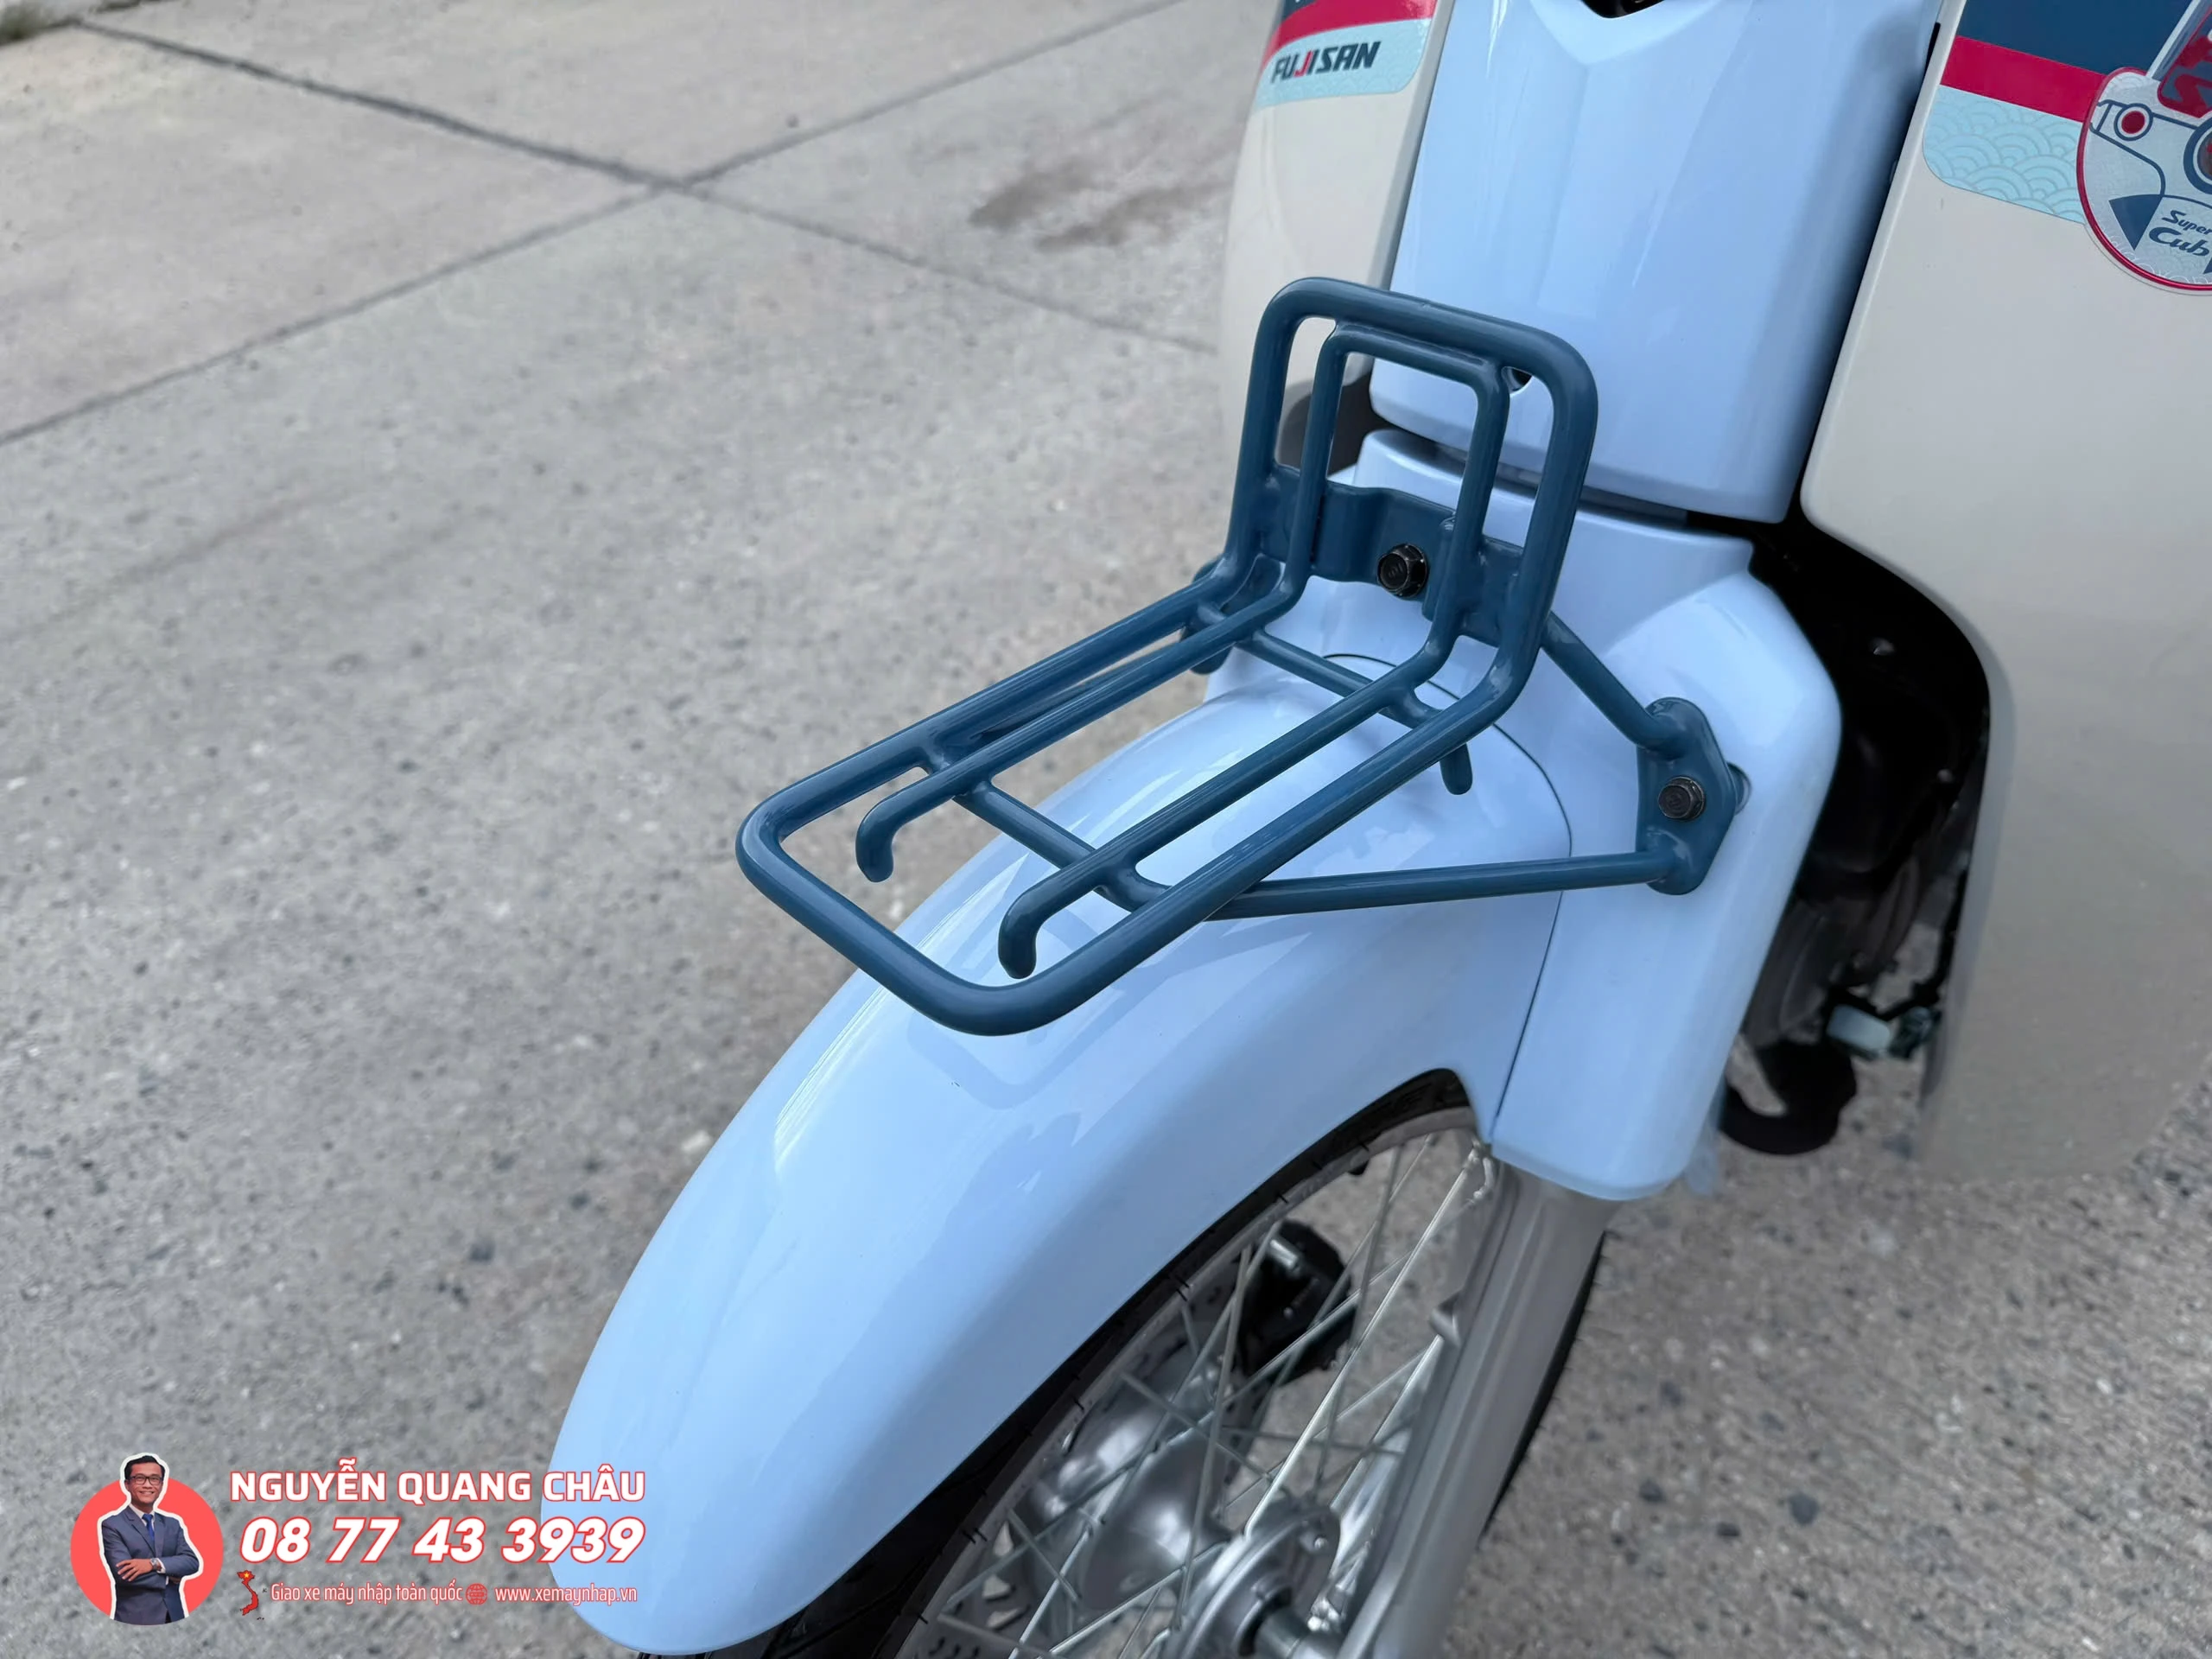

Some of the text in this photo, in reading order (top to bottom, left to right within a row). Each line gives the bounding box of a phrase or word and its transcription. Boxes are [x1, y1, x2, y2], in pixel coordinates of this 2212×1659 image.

[1270, 41, 1382, 84] FUJISAN
[2161, 210, 2212, 234] Super
[2149, 226, 2209, 257] Cub
